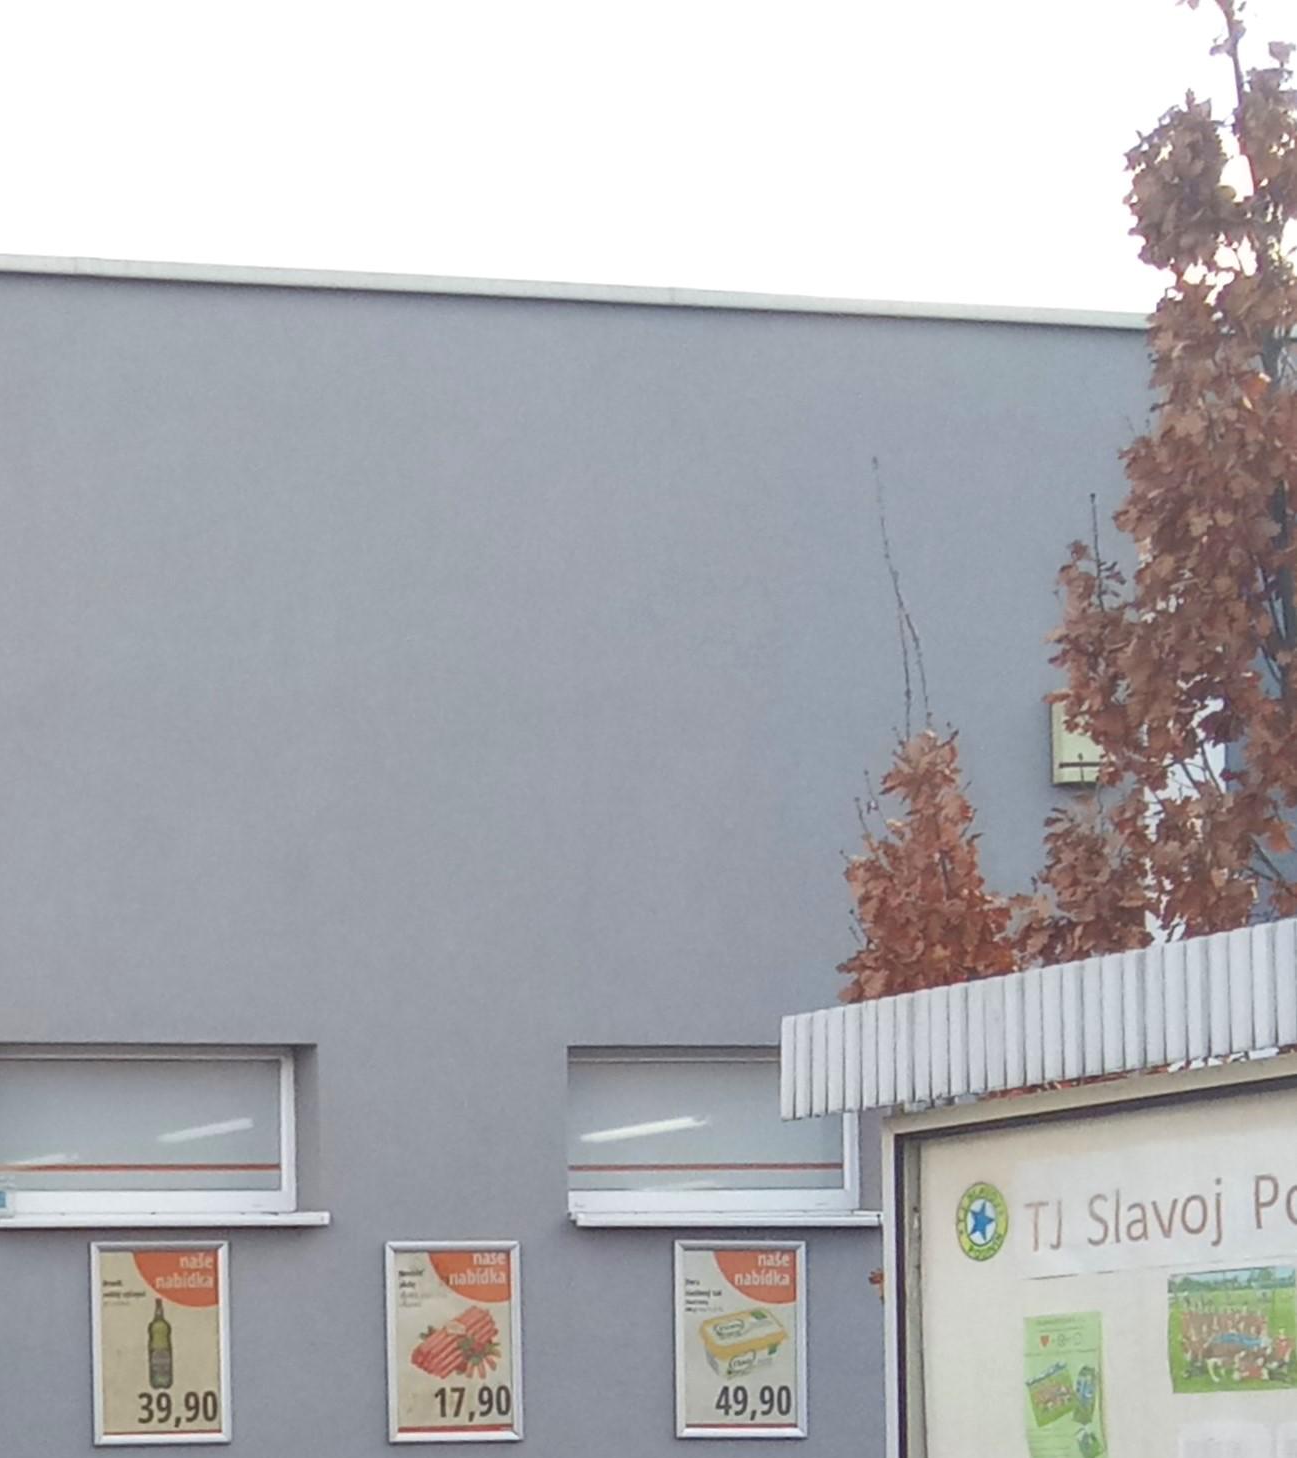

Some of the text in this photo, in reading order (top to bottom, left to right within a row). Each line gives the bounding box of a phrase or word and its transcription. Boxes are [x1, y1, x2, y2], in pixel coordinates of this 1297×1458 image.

[1024, 1200, 1063, 1252] TJ
[1087, 1177, 1223, 1247] Slavoj
[179, 1253, 214, 1269] naše
[757, 1252, 790, 1268] naše
[156, 1272, 214, 1289] nabídka
[448, 1270, 507, 1286] nabídka
[733, 1271, 790, 1287] nabídka
[138, 1390, 218, 1428] 39,90
[434, 1385, 512, 1422] 17,90
[715, 1385, 792, 1421] 49,90
